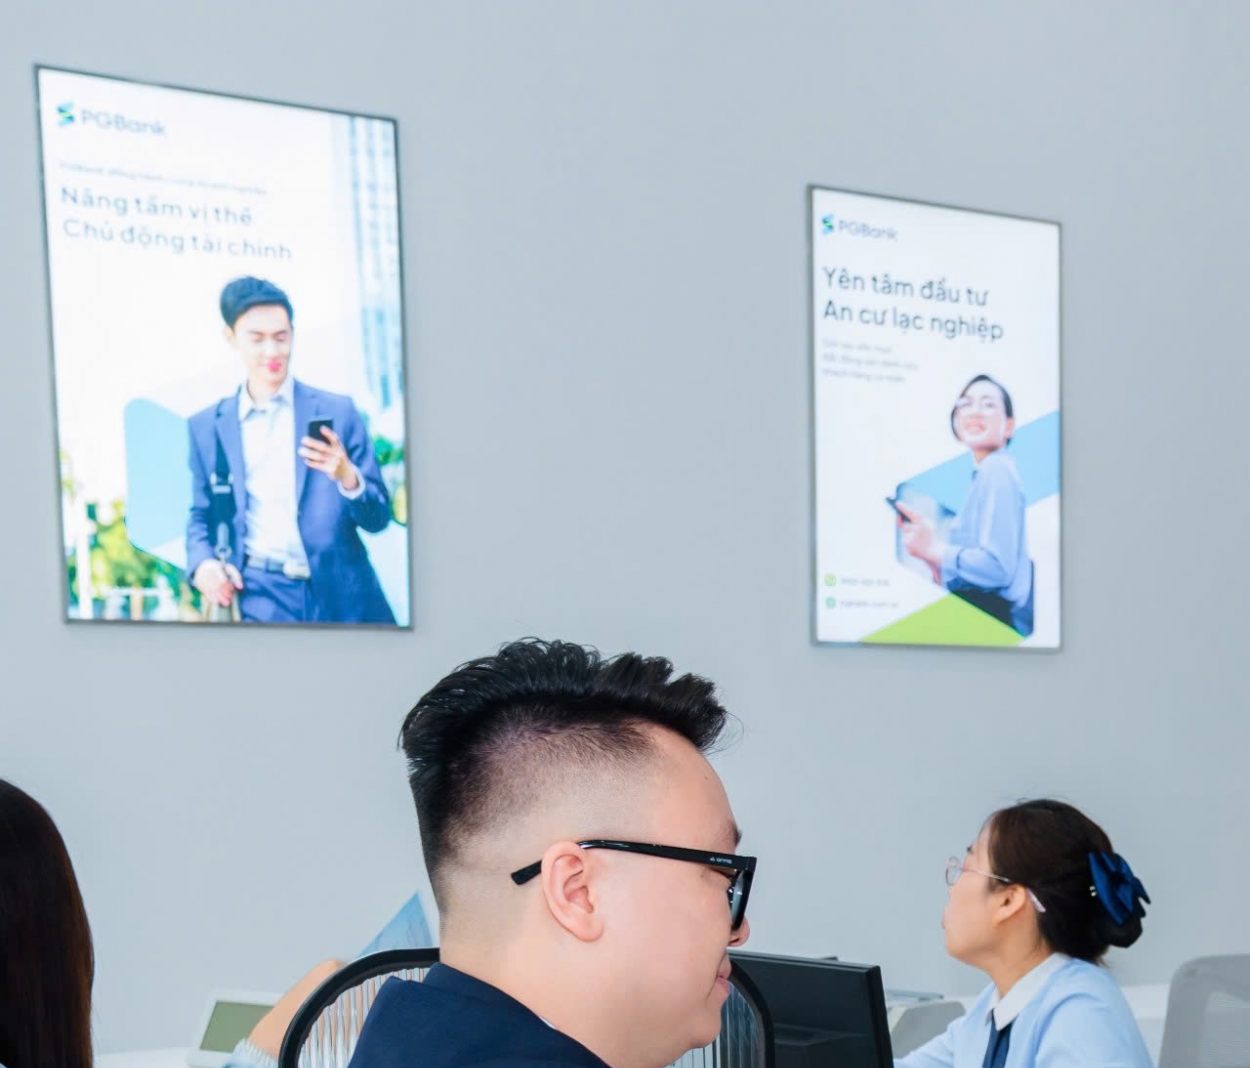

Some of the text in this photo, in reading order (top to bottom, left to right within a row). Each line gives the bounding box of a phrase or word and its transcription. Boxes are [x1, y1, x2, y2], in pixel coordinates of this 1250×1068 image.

[82, 109, 164, 135] PGBank
[62, 218, 114, 242] Chủ
[120, 226, 185, 253] động
[838, 219, 898, 242] PGBank
[823, 267, 865, 291] Yên
[871, 273, 914, 297] tâm
[966, 287, 989, 307] tư
[824, 300, 1004, 343] An cư lạc nghiệp
